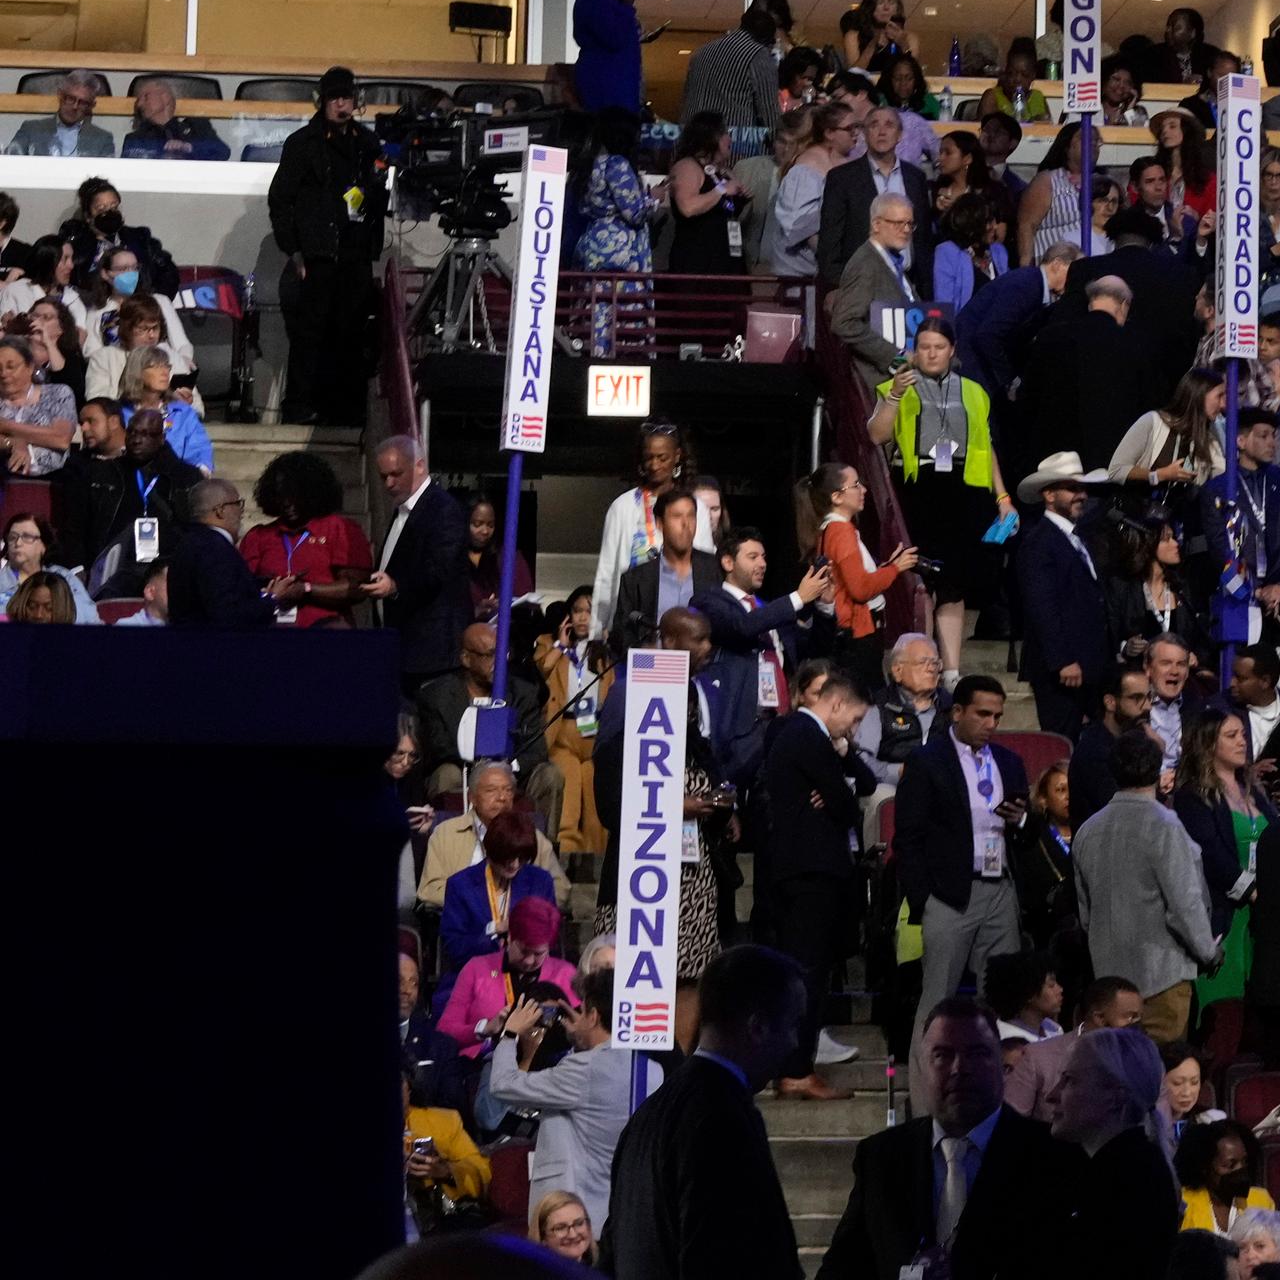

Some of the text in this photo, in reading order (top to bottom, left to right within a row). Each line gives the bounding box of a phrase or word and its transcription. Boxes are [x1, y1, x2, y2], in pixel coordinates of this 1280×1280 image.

[1233, 108, 1254, 315] COLORADO
[519, 180, 555, 404] LOUISIANA
[595, 375, 644, 407] EXIT
[624, 696, 675, 989] ARIZONA
[617, 1001, 633, 1043] DNC
[633, 1034, 668, 1044] 2024
